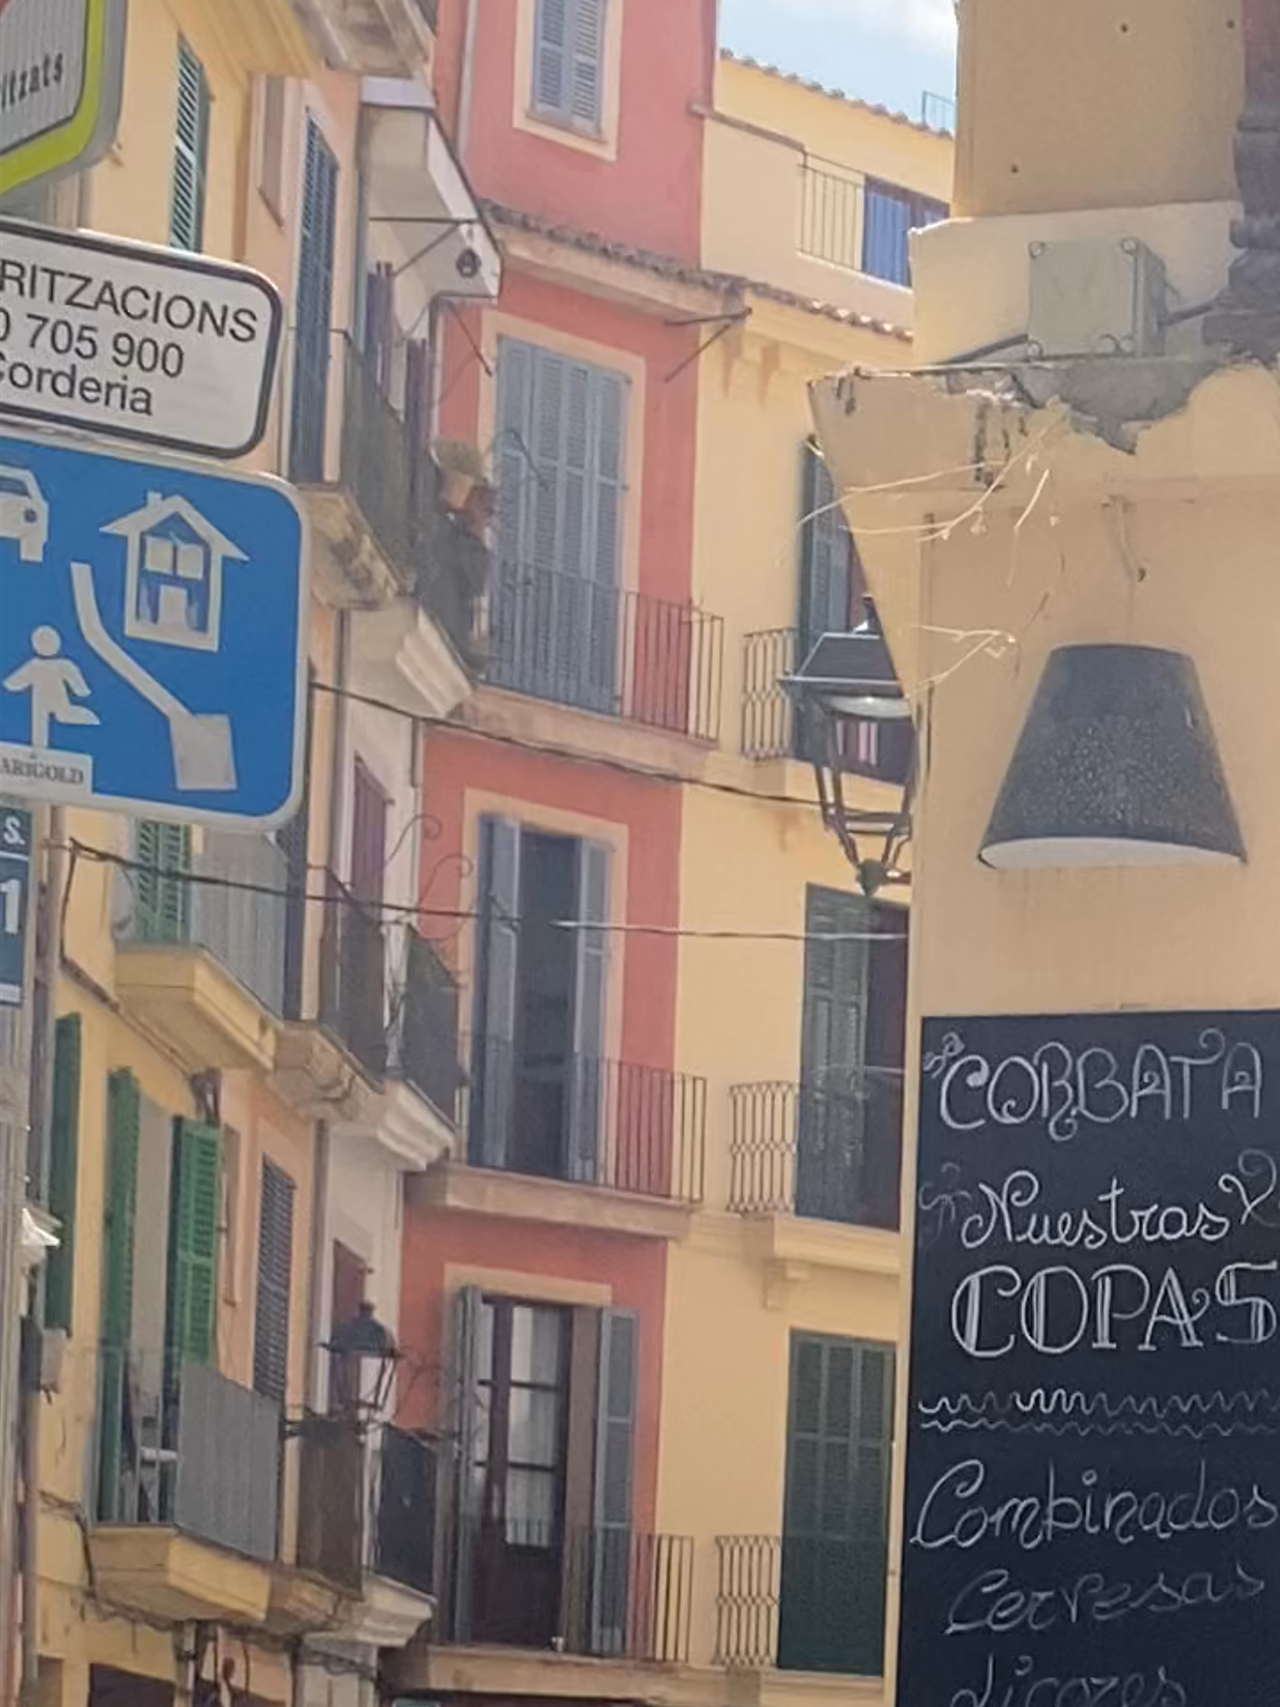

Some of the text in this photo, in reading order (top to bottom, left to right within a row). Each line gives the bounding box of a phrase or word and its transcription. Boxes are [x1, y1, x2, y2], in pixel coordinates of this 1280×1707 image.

[0, 258, 258, 343] RITZACIONS
[0, 351, 153, 416] orderia
[26, 313, 99, 360] 705
[111, 331, 185, 379] 900
[939, 1028, 1262, 1140] CORBATA
[961, 1170, 1230, 1249] Nuestras
[951, 1260, 1278, 1357] COPAS
[909, 1459, 1279, 1549] Combinados
